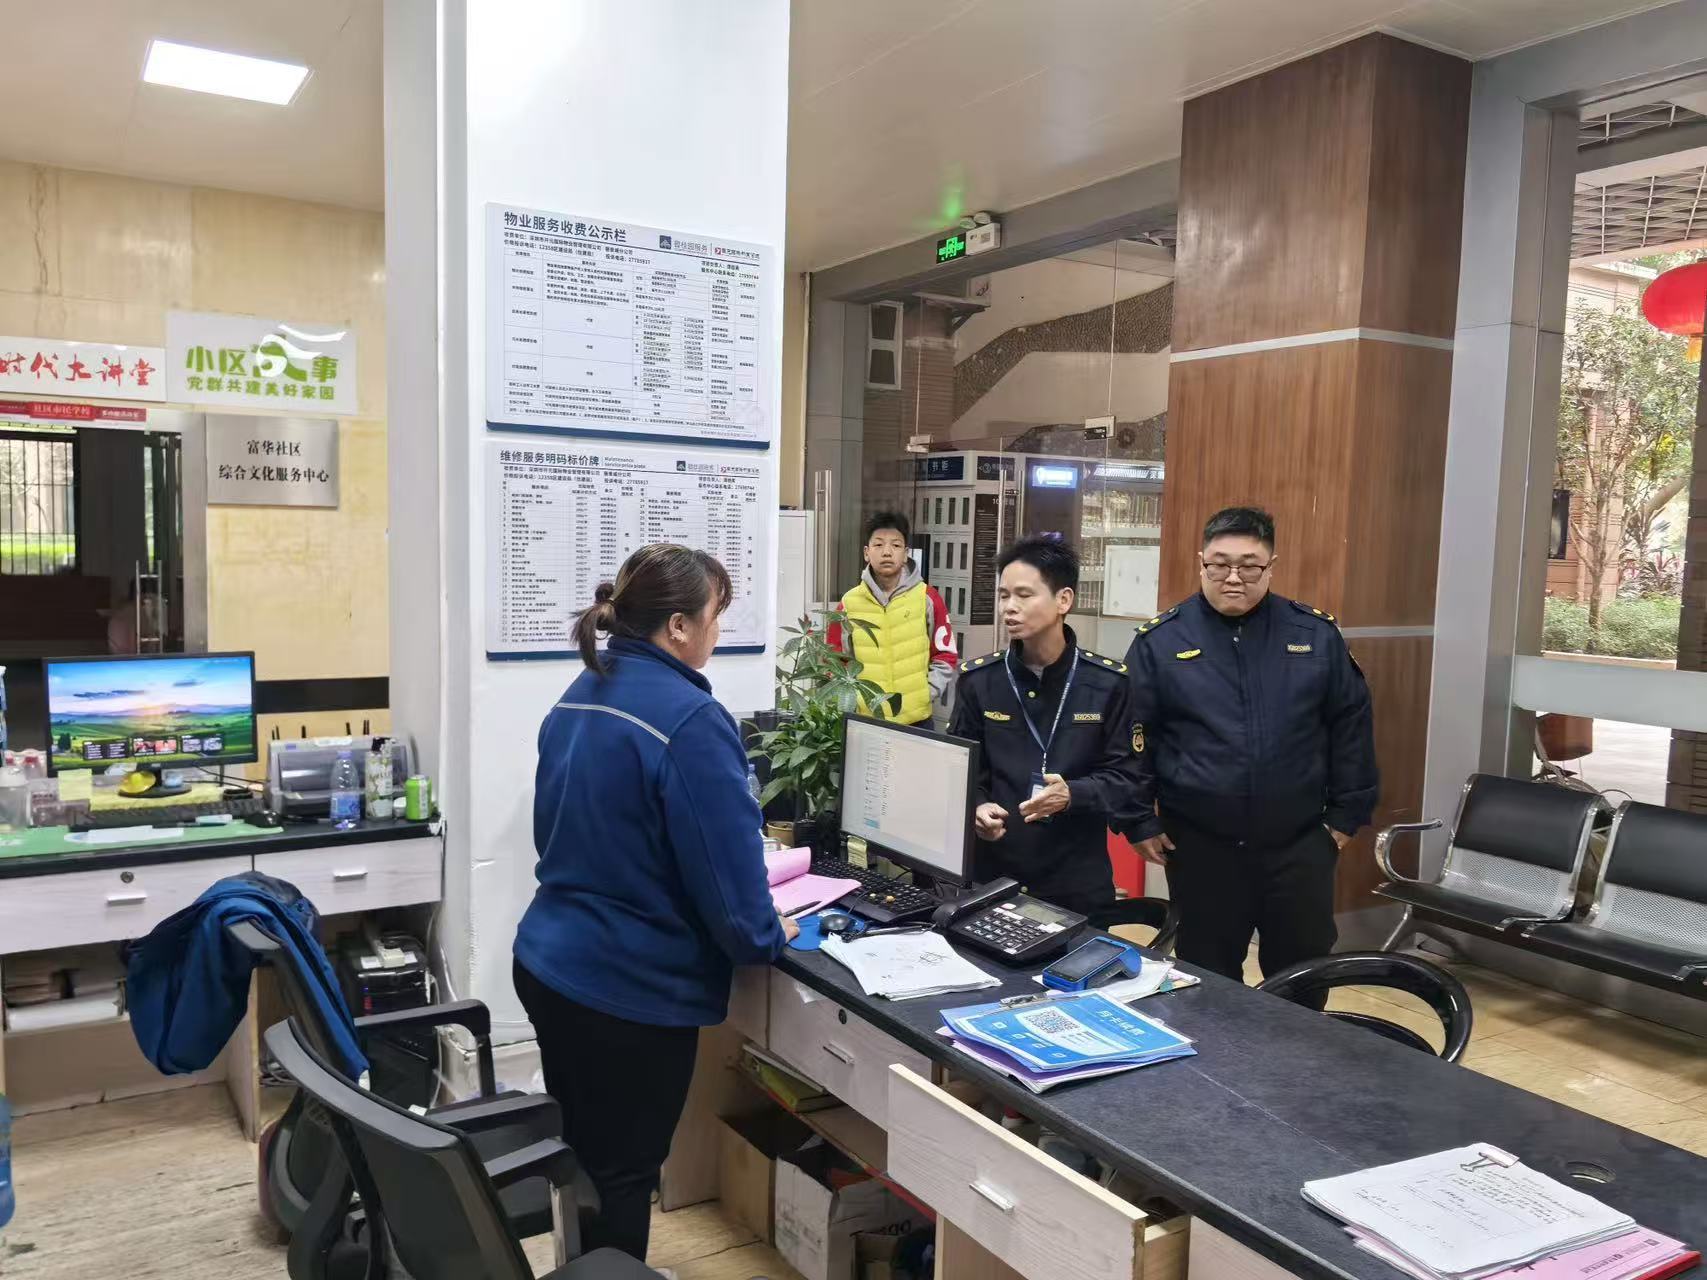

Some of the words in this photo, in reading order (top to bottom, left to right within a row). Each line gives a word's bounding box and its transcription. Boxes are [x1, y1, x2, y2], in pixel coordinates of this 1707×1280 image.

[504, 211, 627, 243] 物业服务收费公示栏
[186, 376, 335, 400] 党群共建美好家园
[246, 439, 302, 457] 富华社区
[500, 449, 600, 467] 维修服务明码标价牌
[218, 465, 330, 484] 综合文化服务中心
